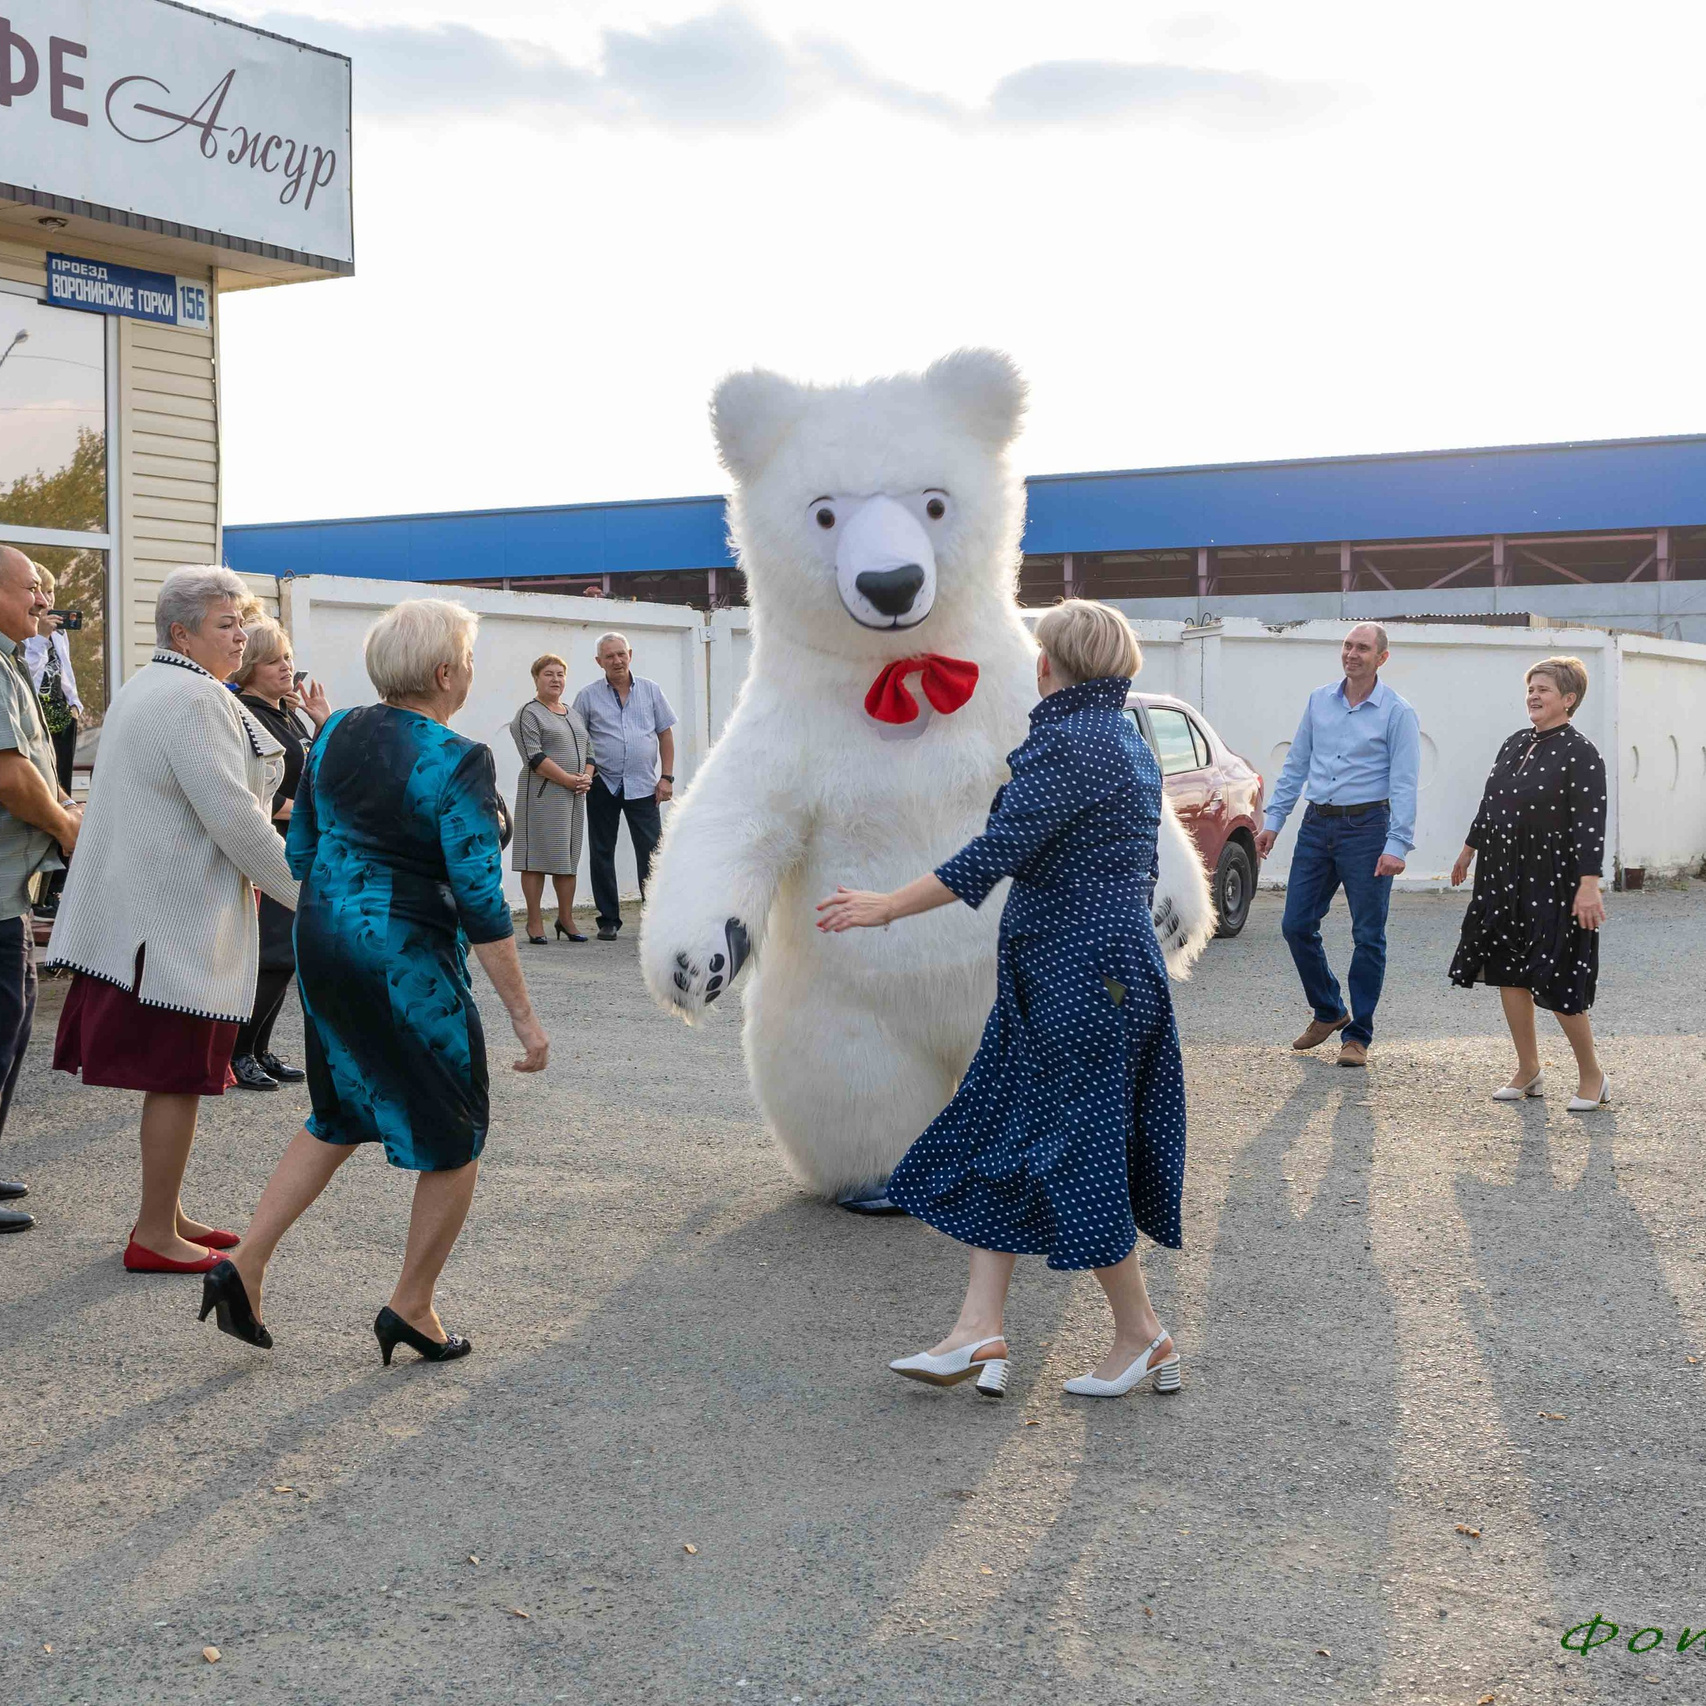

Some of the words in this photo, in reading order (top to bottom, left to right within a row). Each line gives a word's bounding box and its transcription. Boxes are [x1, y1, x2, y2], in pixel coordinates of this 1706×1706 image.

[105, 69, 337, 211] Ажур
[52, 258, 108, 281] ПРОЕЗД
[52, 273, 135, 311] ВОРОНИНСКИЕ
[138, 289, 174, 317] ГОРКИ
[179, 285, 206, 322] 156
